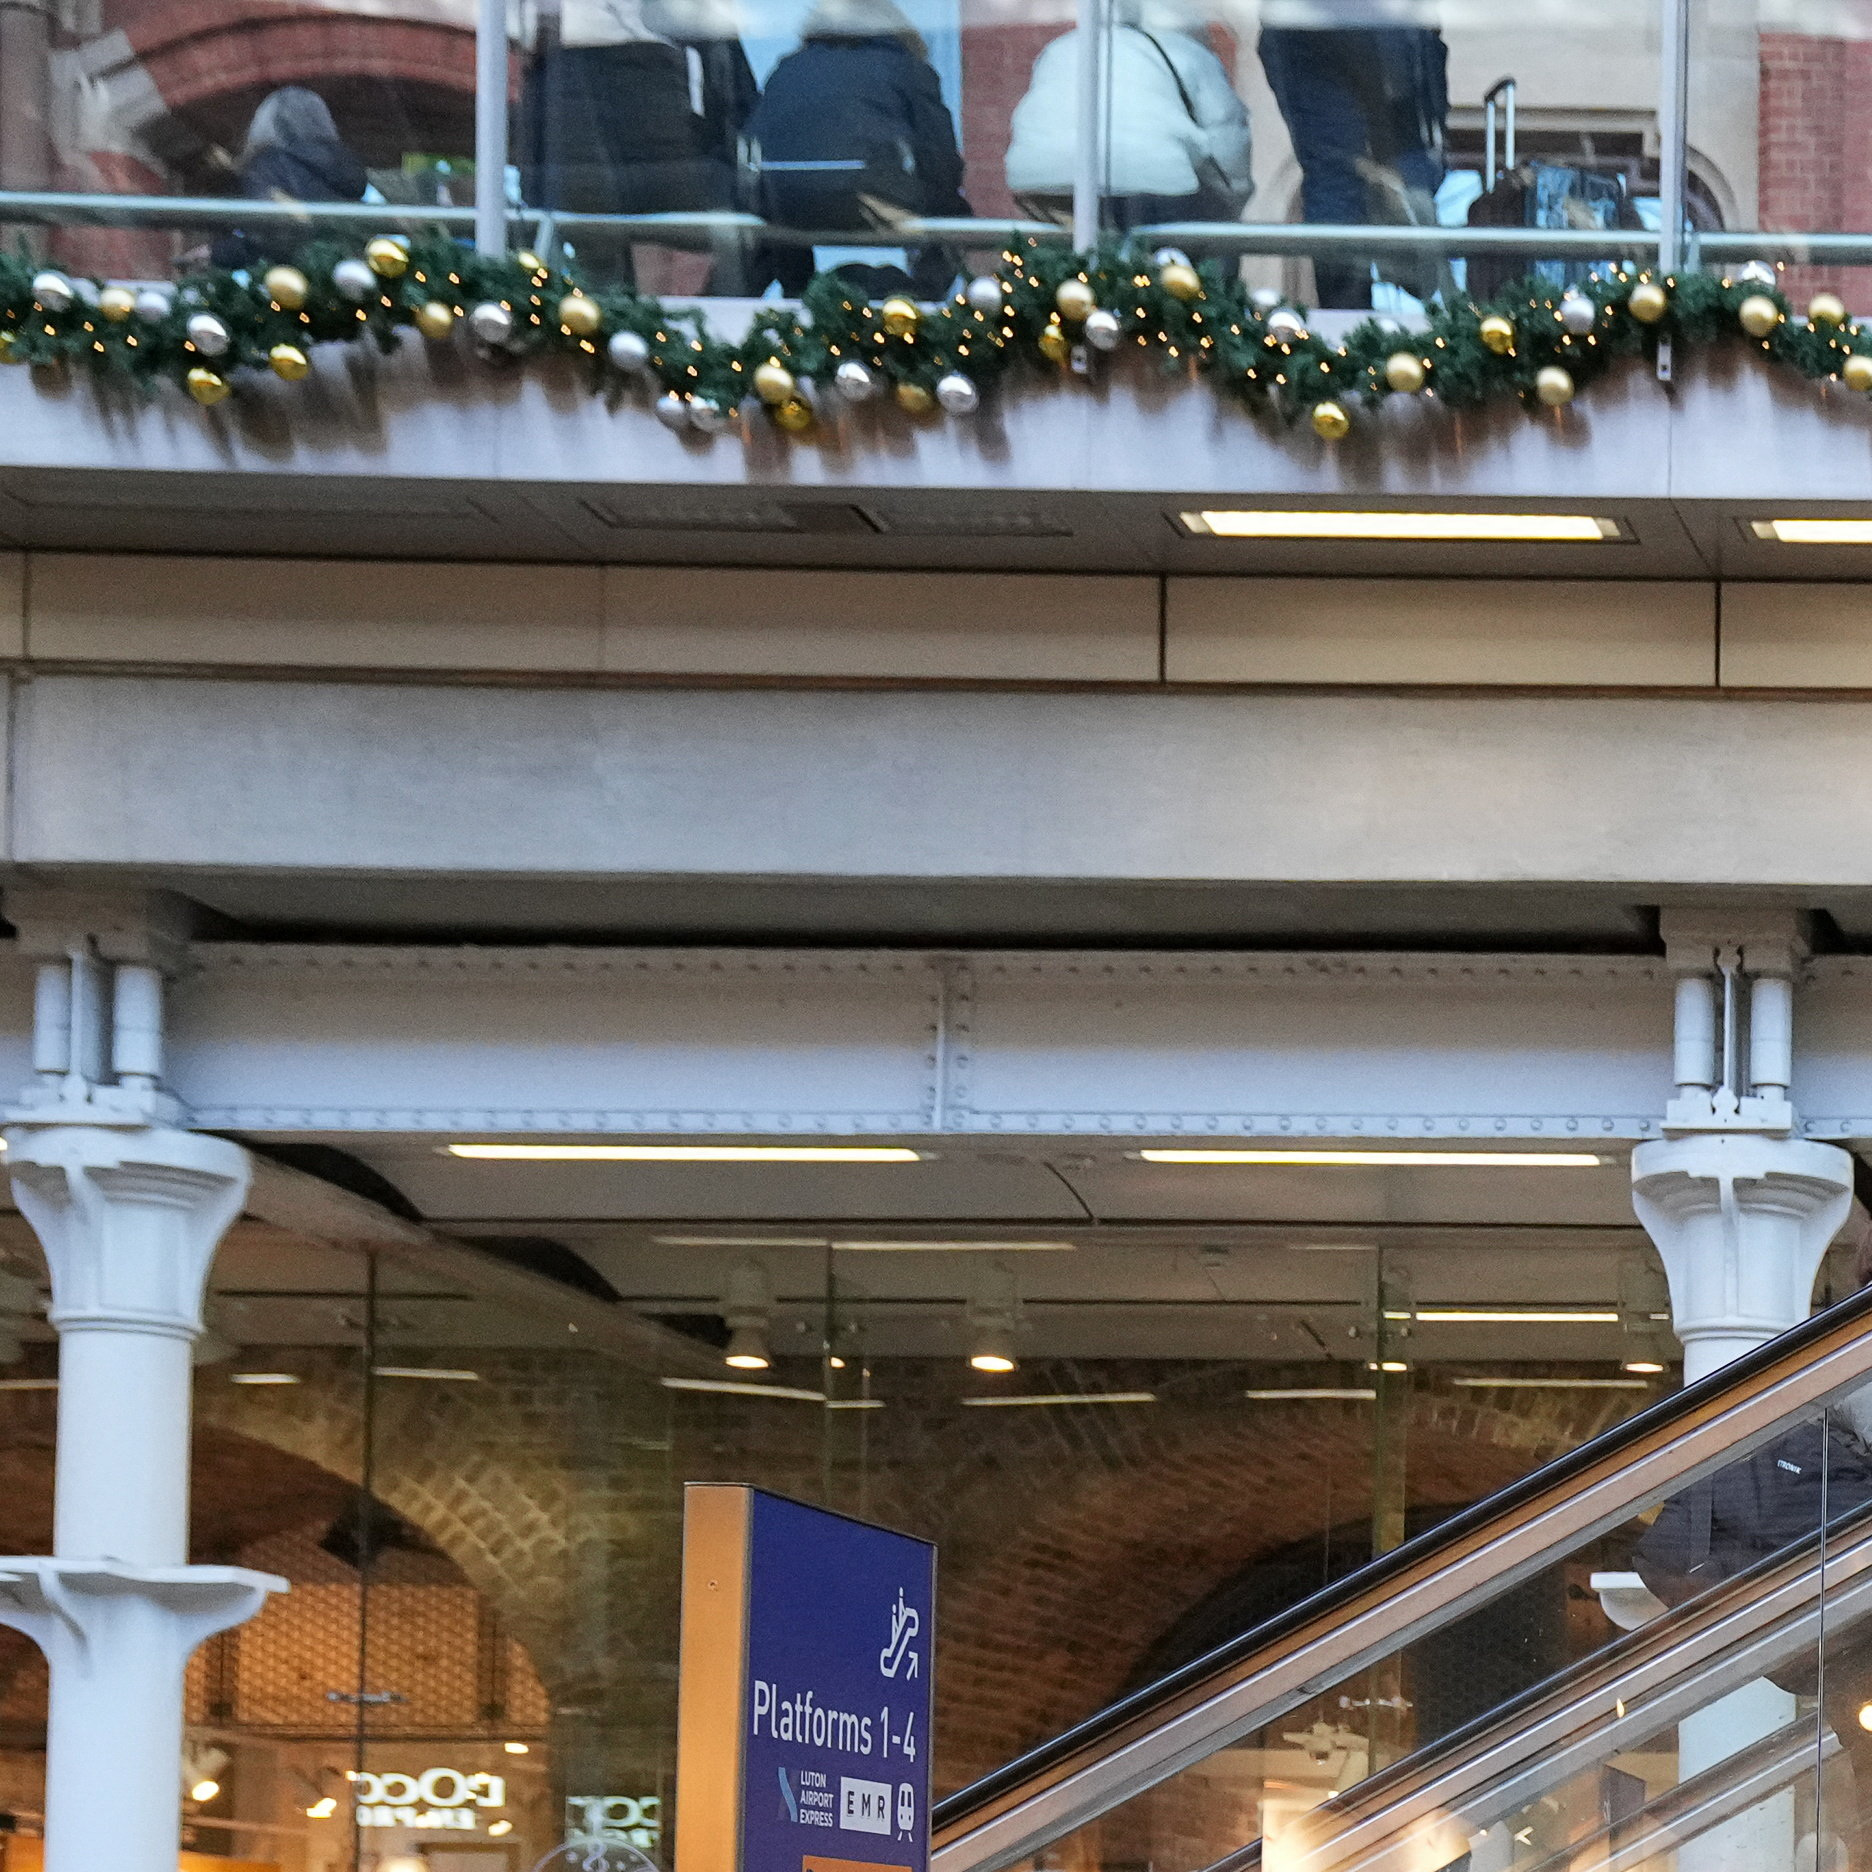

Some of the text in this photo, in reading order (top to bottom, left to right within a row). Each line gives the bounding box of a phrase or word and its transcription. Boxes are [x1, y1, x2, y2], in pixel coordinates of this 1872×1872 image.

[753, 1680, 917, 1764] Platforms 1-4
[800, 1771, 827, 1788] LUTON
[800, 1789, 835, 1809] AIRPORT
[799, 1809, 834, 1828] EXPRESS
